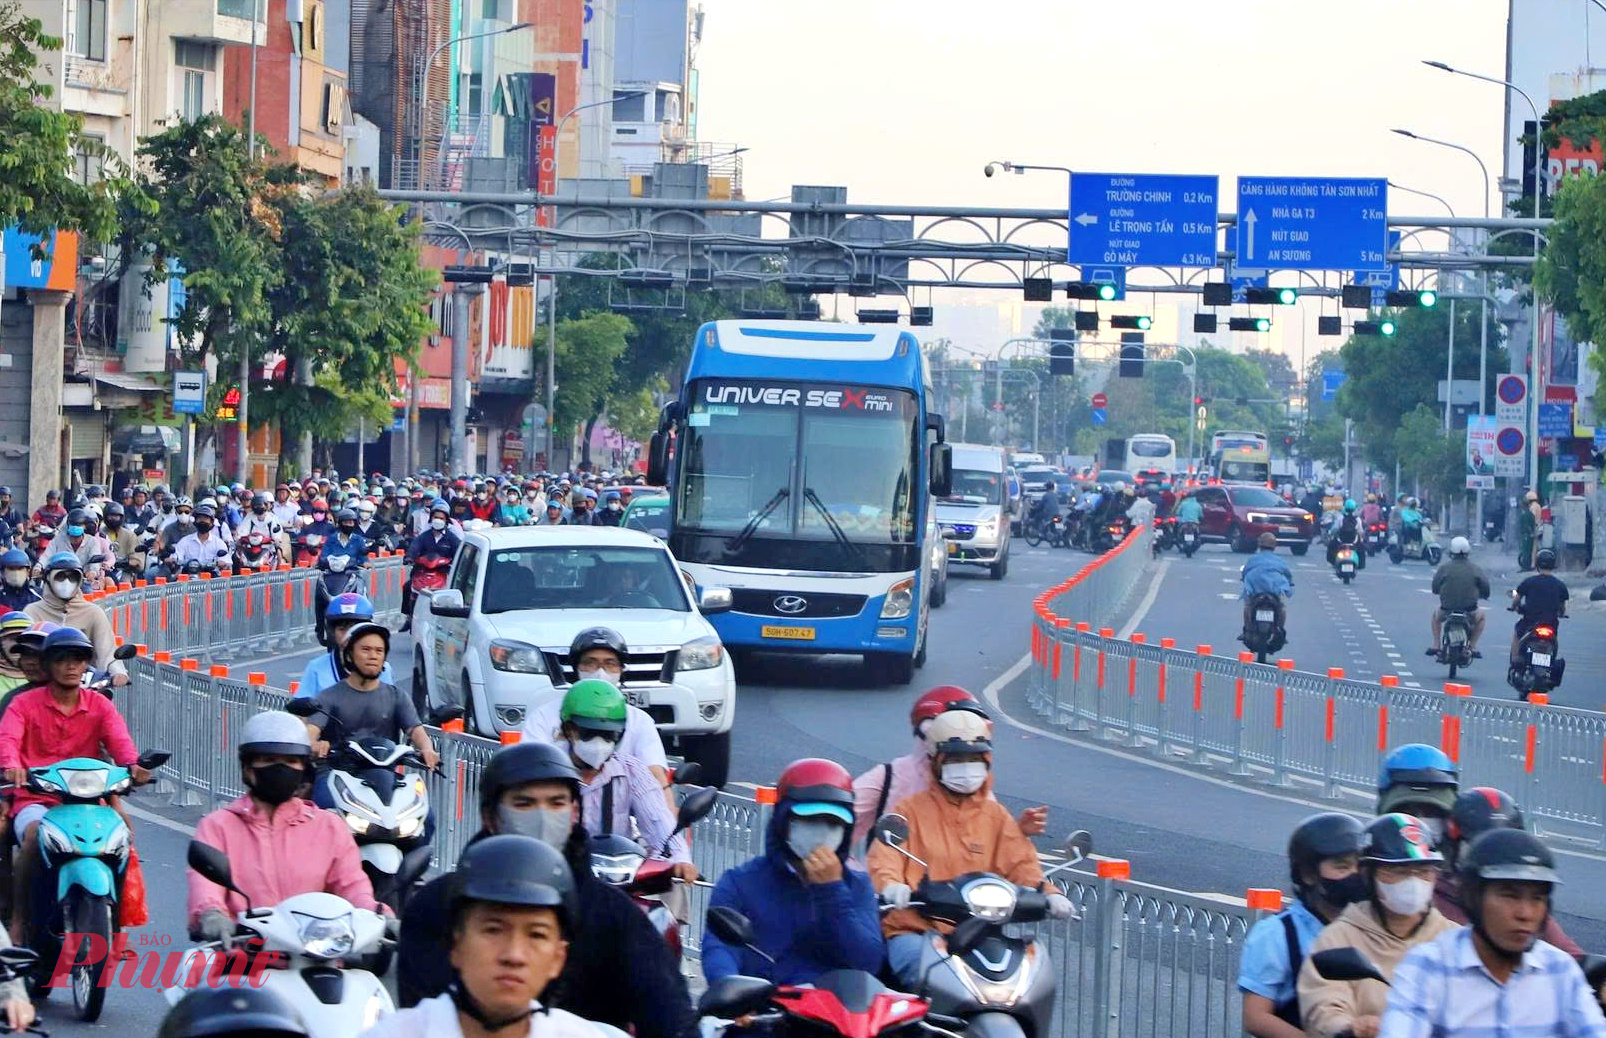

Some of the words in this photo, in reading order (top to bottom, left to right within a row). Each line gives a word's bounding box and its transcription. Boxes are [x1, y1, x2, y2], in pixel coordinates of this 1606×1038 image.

[1106, 189, 1142, 202] TRƯỜNG
[1144, 192, 1172, 202] CHINH
[1241, 182, 1263, 196] CẢNG
[1265, 181, 1288, 196] HÀNG
[1290, 183, 1318, 197] KHÔNG
[1320, 183, 1336, 197] TÂN
[1338, 185, 1356, 197] SƠN
[1357, 181, 1379, 197] NHẤT
[1183, 192, 1196, 203] 0.2
[1198, 193, 1213, 203] Km
[1272, 204, 1290, 218] NHÀ
[1291, 207, 1303, 219] GA
[1304, 207, 1315, 219] T3
[1362, 209, 1369, 219] 2
[1370, 209, 1384, 220] Km
[1109, 219, 1120, 232] LÊ
[1123, 221, 1152, 235] TRỌNG
[1155, 217, 1174, 233] TẤN
[1183, 222, 1196, 234] 0.5
[1198, 224, 1212, 234] Km
[1271, 228, 1288, 241] NÚT
[1290, 231, 1309, 241] GIAO
[1124, 240, 1141, 248] GIAO
[1104, 250, 1116, 263] GÒ
[1118, 250, 1138, 263] MÂY
[1196, 254, 1211, 265] Km
[1268, 250, 1280, 261] AN
[1281, 249, 1311, 262] SƯƠNG
[1361, 251, 1367, 262] 5
[1368, 251, 1383, 262] Km
